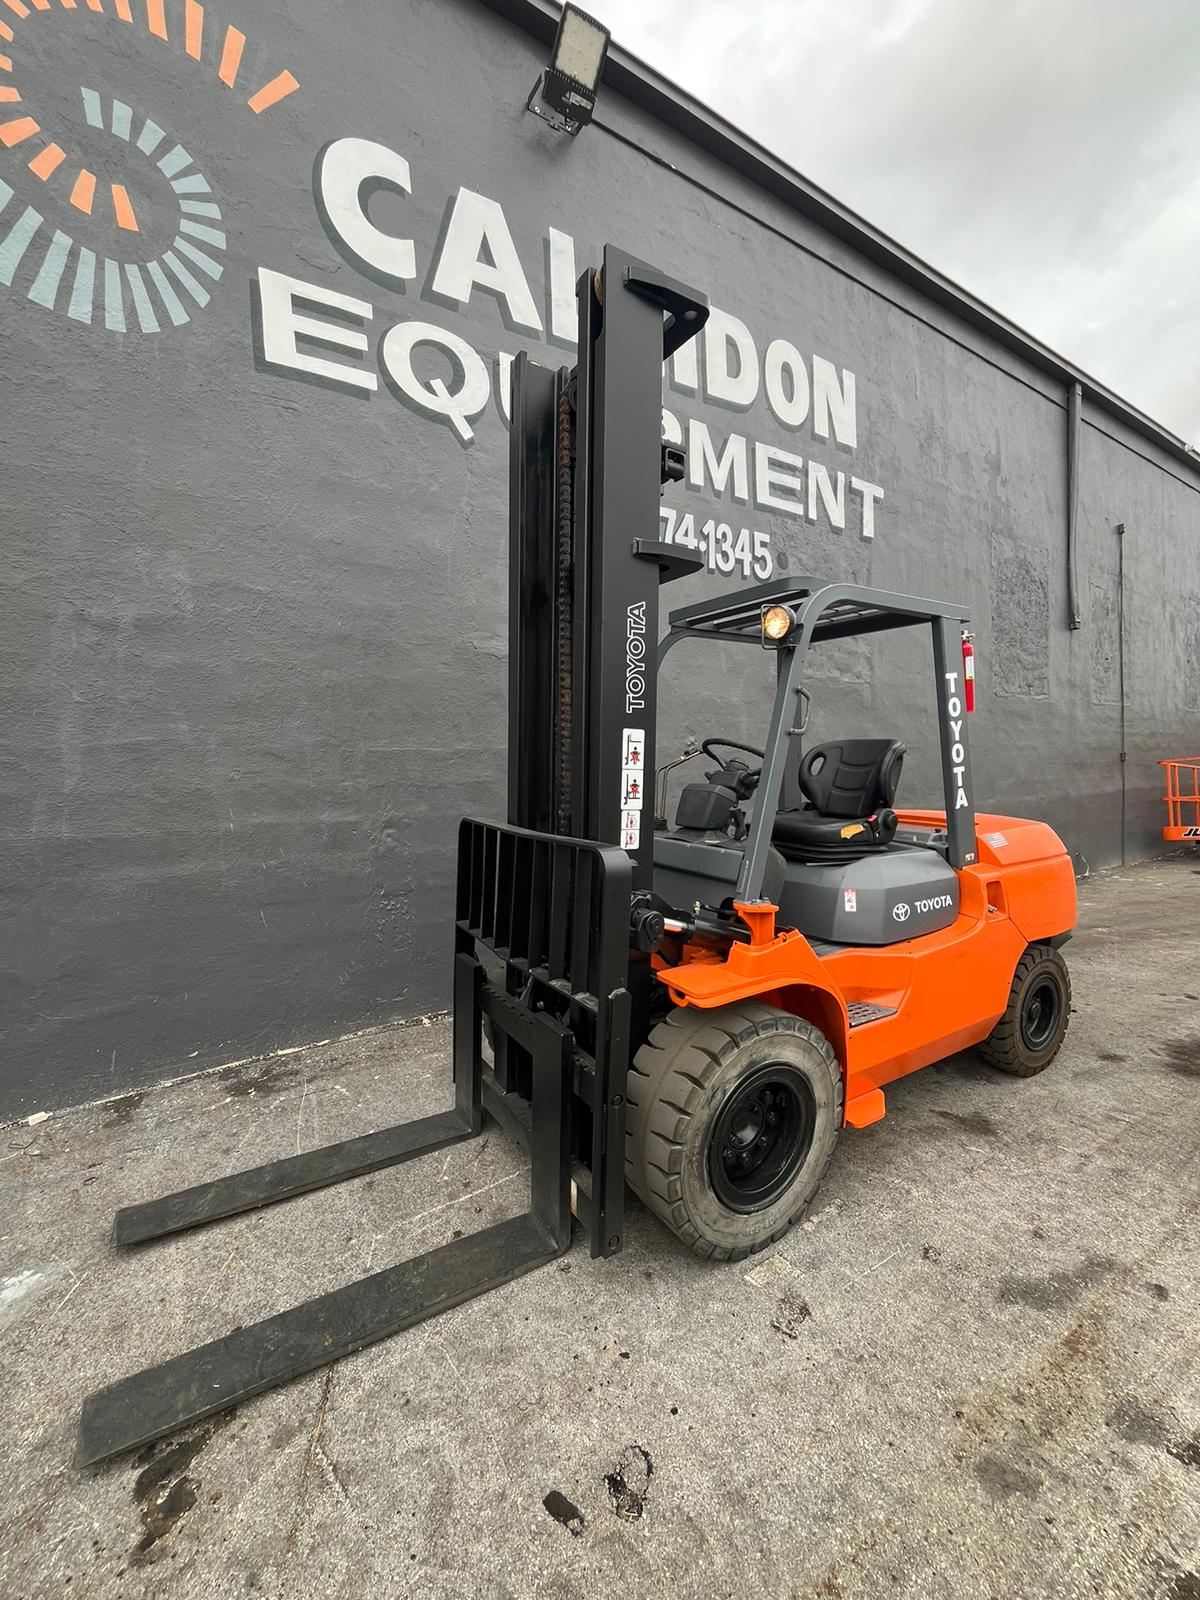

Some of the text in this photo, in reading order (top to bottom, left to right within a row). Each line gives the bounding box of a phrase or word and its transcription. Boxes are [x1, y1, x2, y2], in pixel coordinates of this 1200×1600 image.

[659, 506, 773, 580] 74.1345
[626, 601, 646, 714] TOYOTA
[945, 672, 969, 810] TOYOTA
[914, 894, 953, 914] TOYOTA
